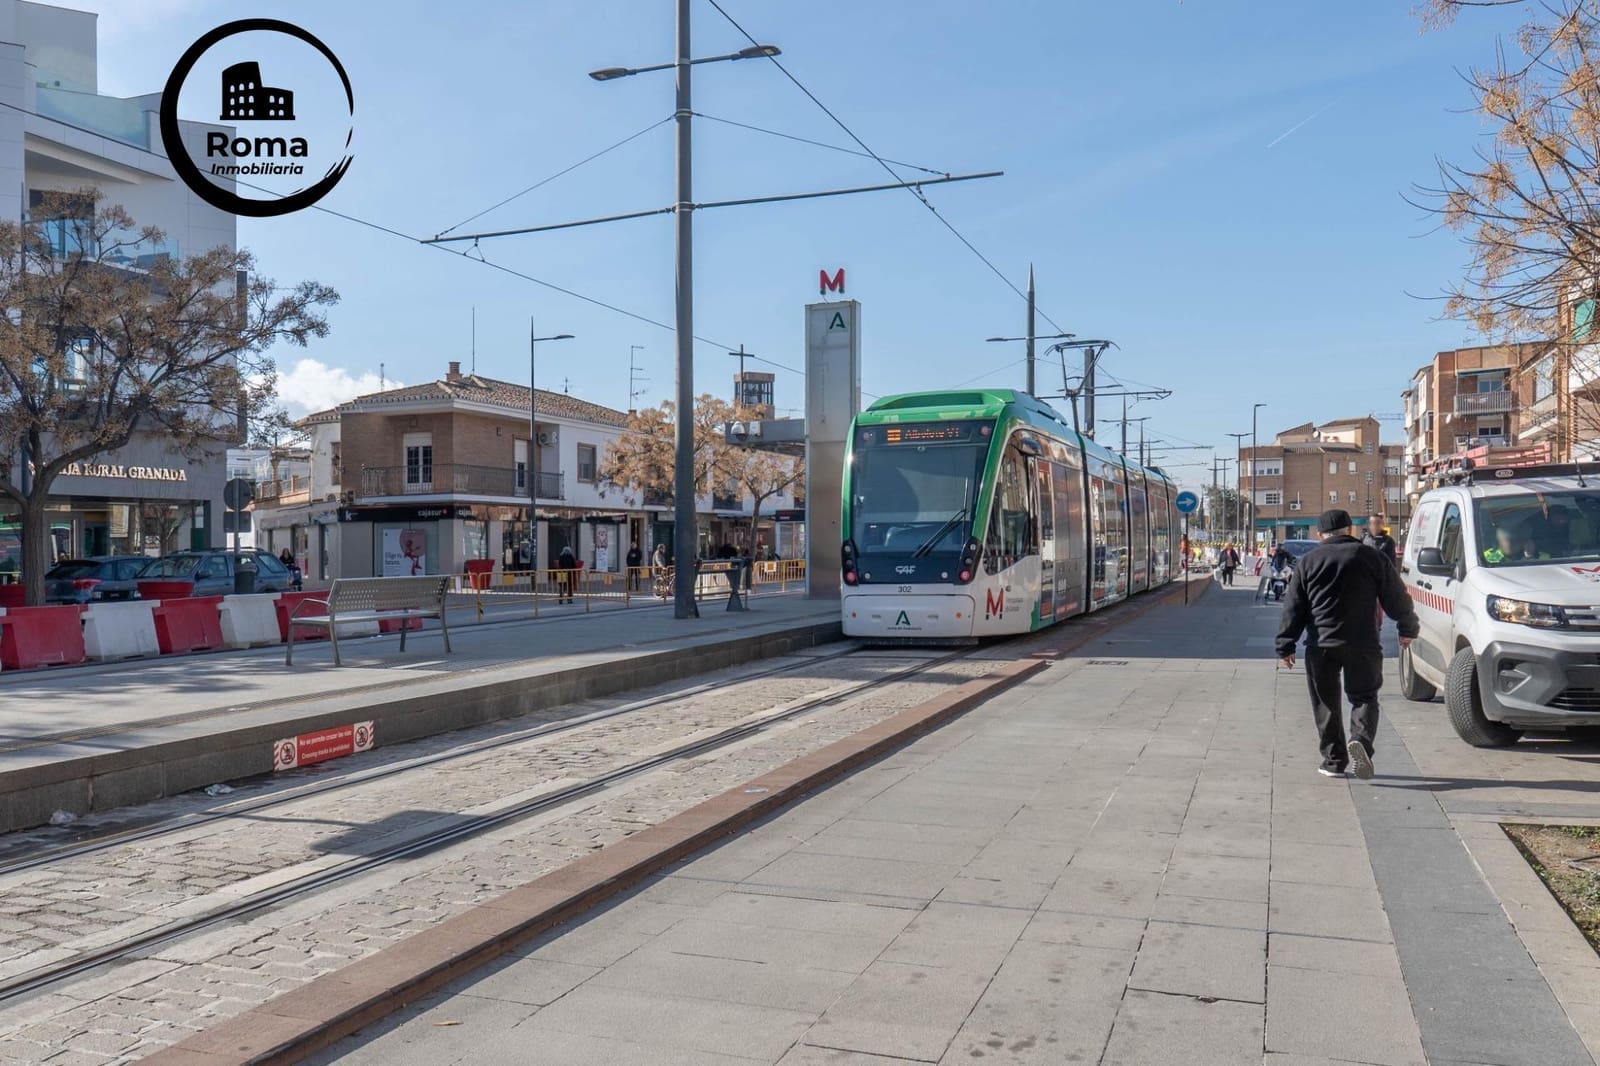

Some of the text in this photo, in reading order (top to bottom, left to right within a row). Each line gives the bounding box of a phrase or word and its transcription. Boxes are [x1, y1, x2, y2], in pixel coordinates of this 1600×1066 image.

[820, 268, 845, 295] M
[84, 463, 126, 478] RURAL
[129, 466, 187, 481] GRANADA
[898, 585, 912, 593] 302
[985, 587, 1004, 620] M
